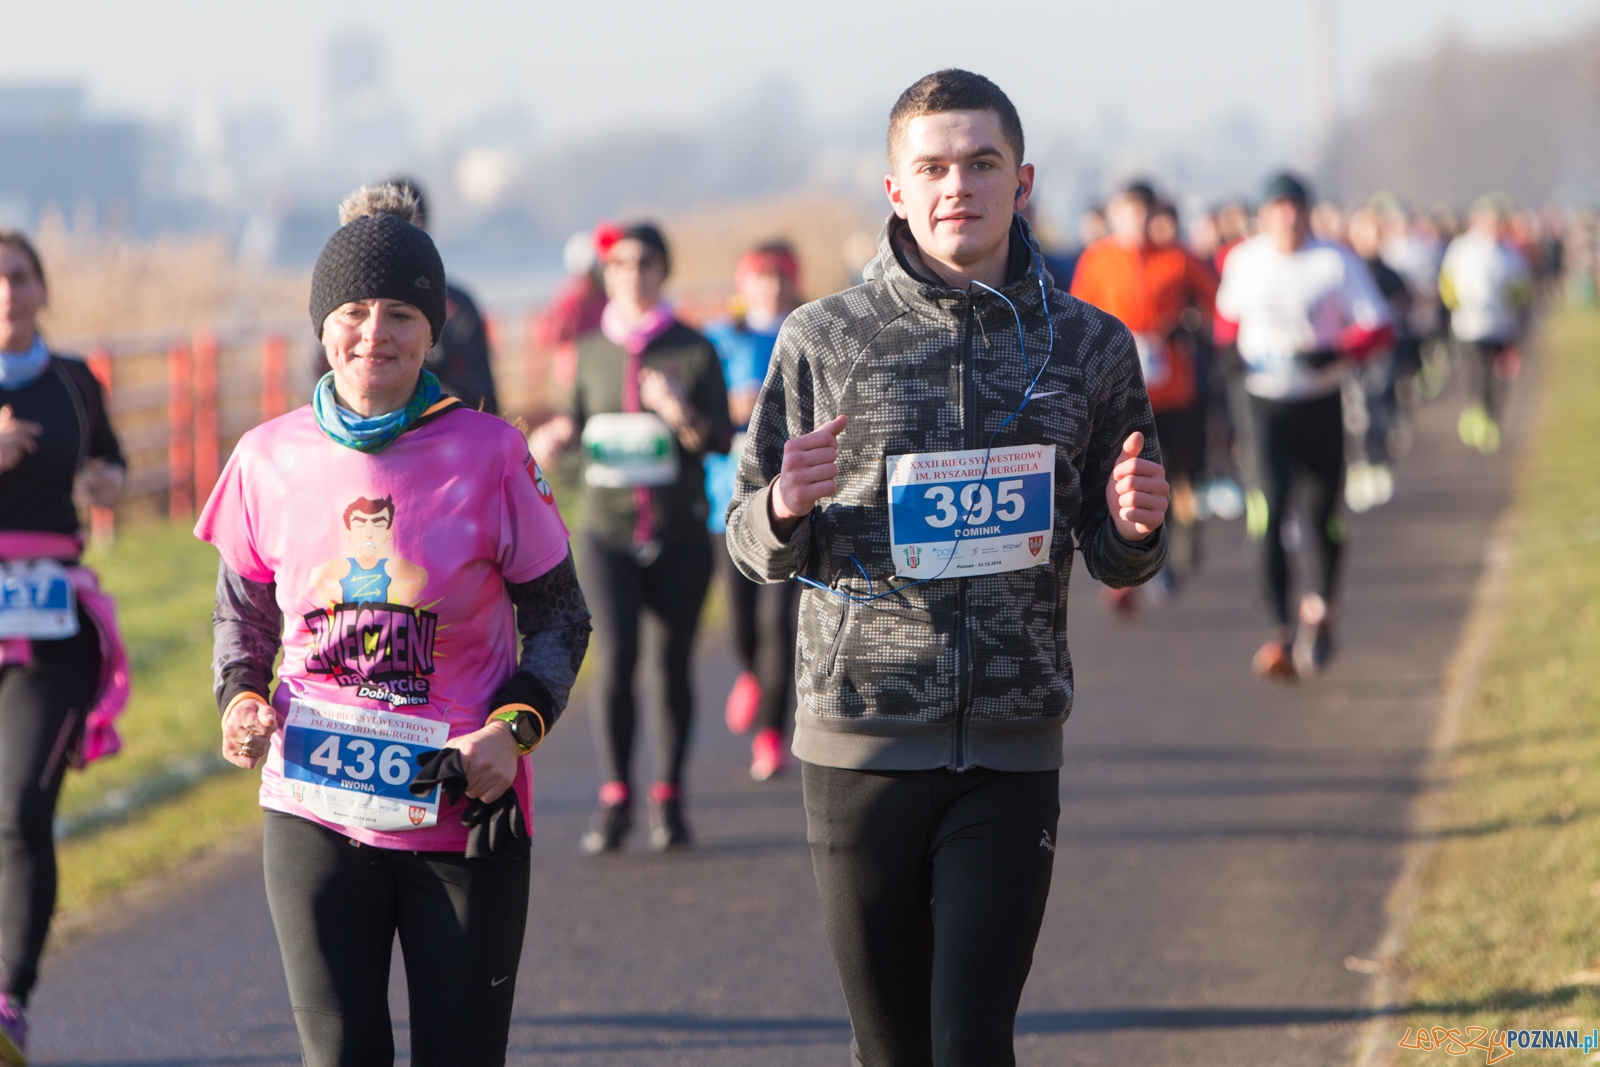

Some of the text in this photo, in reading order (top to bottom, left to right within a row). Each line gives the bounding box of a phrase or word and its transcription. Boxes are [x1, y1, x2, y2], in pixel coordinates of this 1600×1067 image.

[910, 451, 1043, 470] XXXII BIEG SYLWESTROWY
[915, 463, 1039, 481] IM. RYSZARDA BURGIELA
[923, 479, 1026, 529] 395
[954, 525, 1001, 538] DOMINIK
[338, 673, 427, 693] na arcie
[310, 719, 430, 744] IM. RYSZARDA BURGIELA
[336, 711, 358, 722] BIEG
[360, 715, 436, 735] SYLWESTROWY
[309, 735, 412, 786] 436
[341, 779, 375, 793] IWONA
